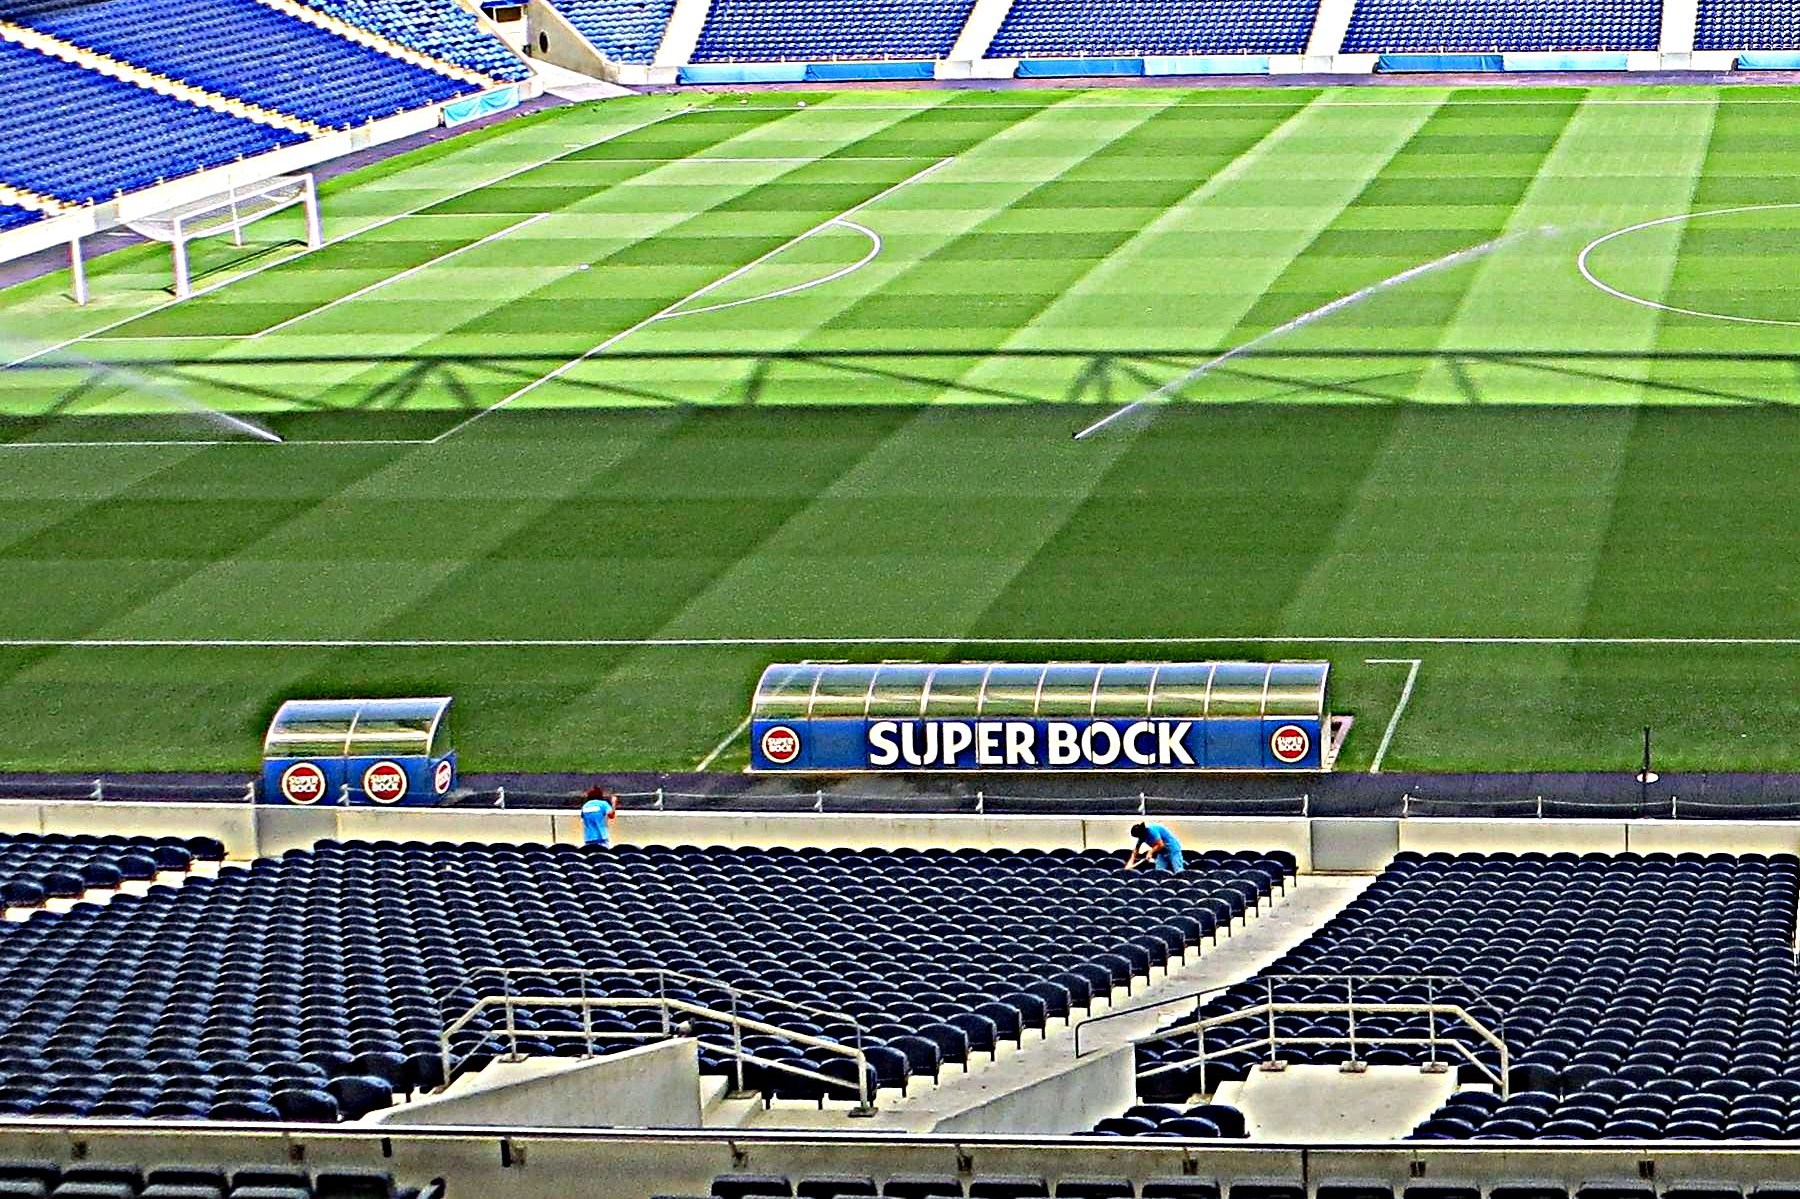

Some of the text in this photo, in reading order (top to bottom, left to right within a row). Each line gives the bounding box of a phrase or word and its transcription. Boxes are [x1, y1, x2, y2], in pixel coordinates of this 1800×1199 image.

[868, 721, 1195, 766] SUPER BOCK
[289, 775, 318, 784] SUPER
[370, 774, 400, 784] SUPER
[290, 783, 317, 792] BOCK
[372, 783, 398, 792] BOCK
